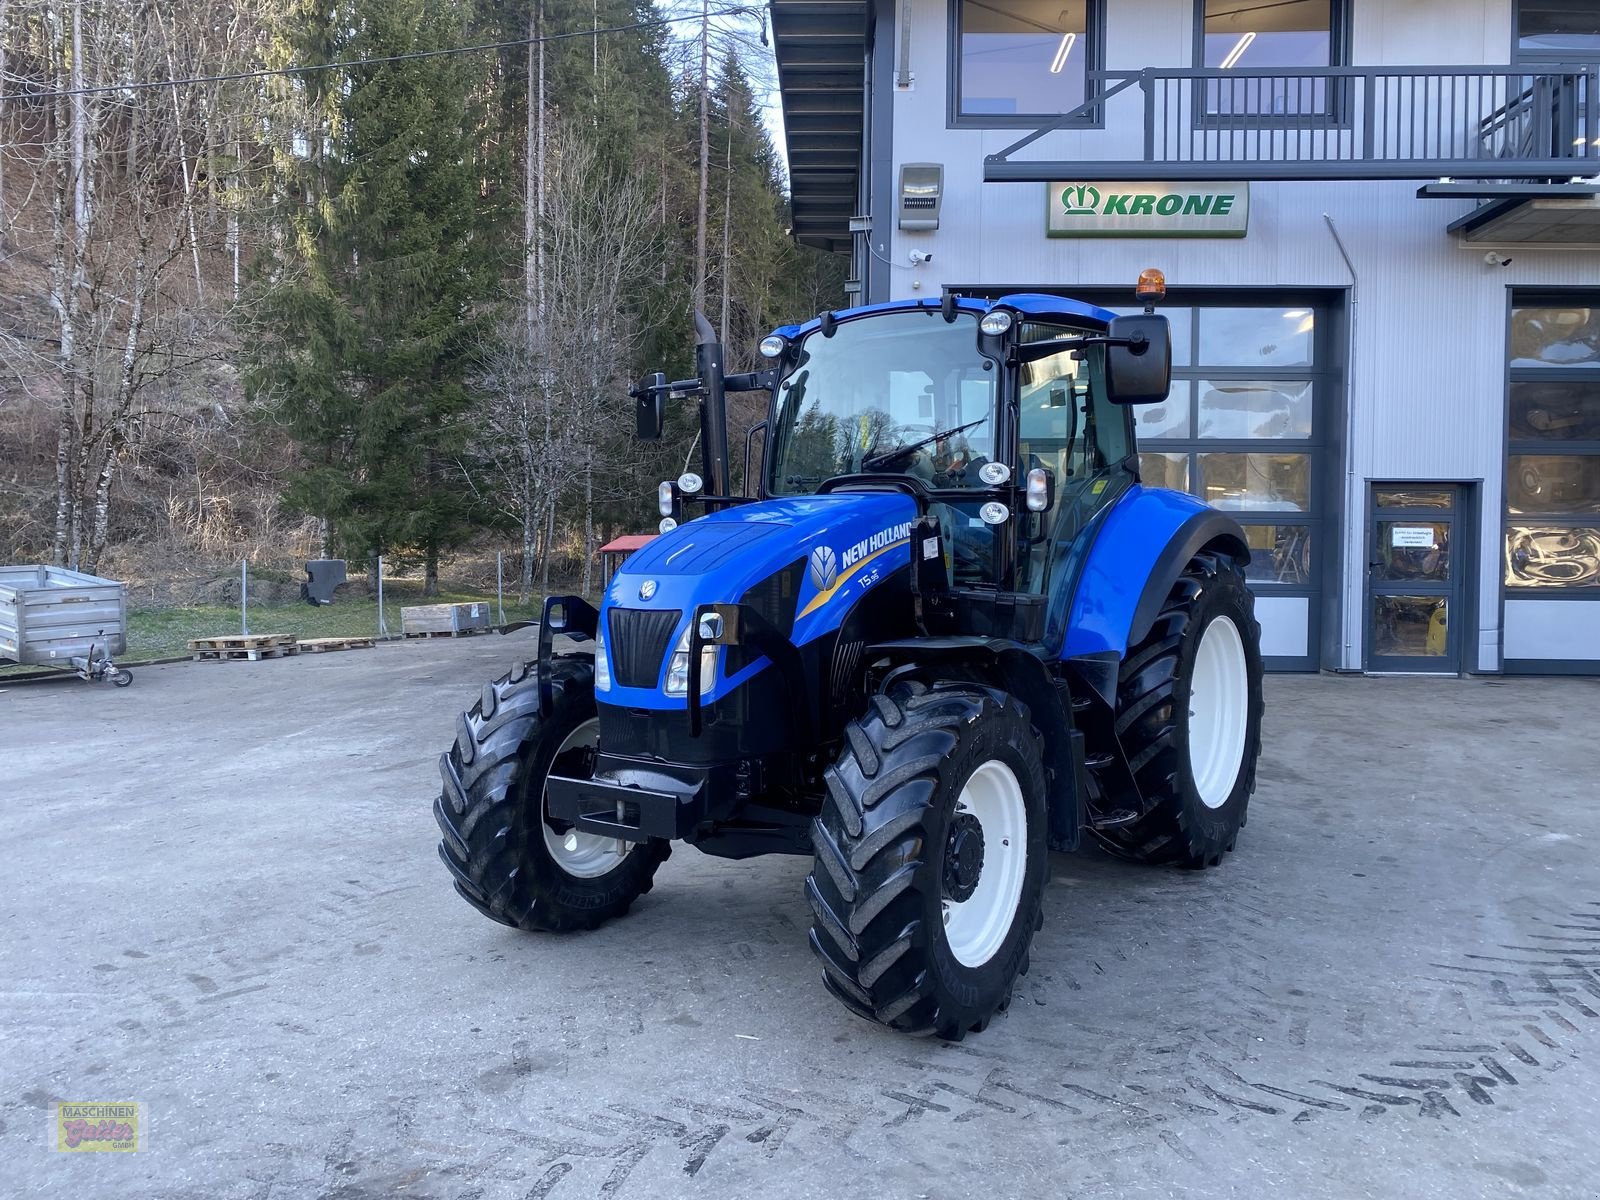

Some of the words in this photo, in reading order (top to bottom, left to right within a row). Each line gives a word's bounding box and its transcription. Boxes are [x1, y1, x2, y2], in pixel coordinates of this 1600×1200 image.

[1102, 194, 1236, 216] KRONE
[842, 541, 869, 569] NEW
[869, 521, 912, 552] HOLLAND
